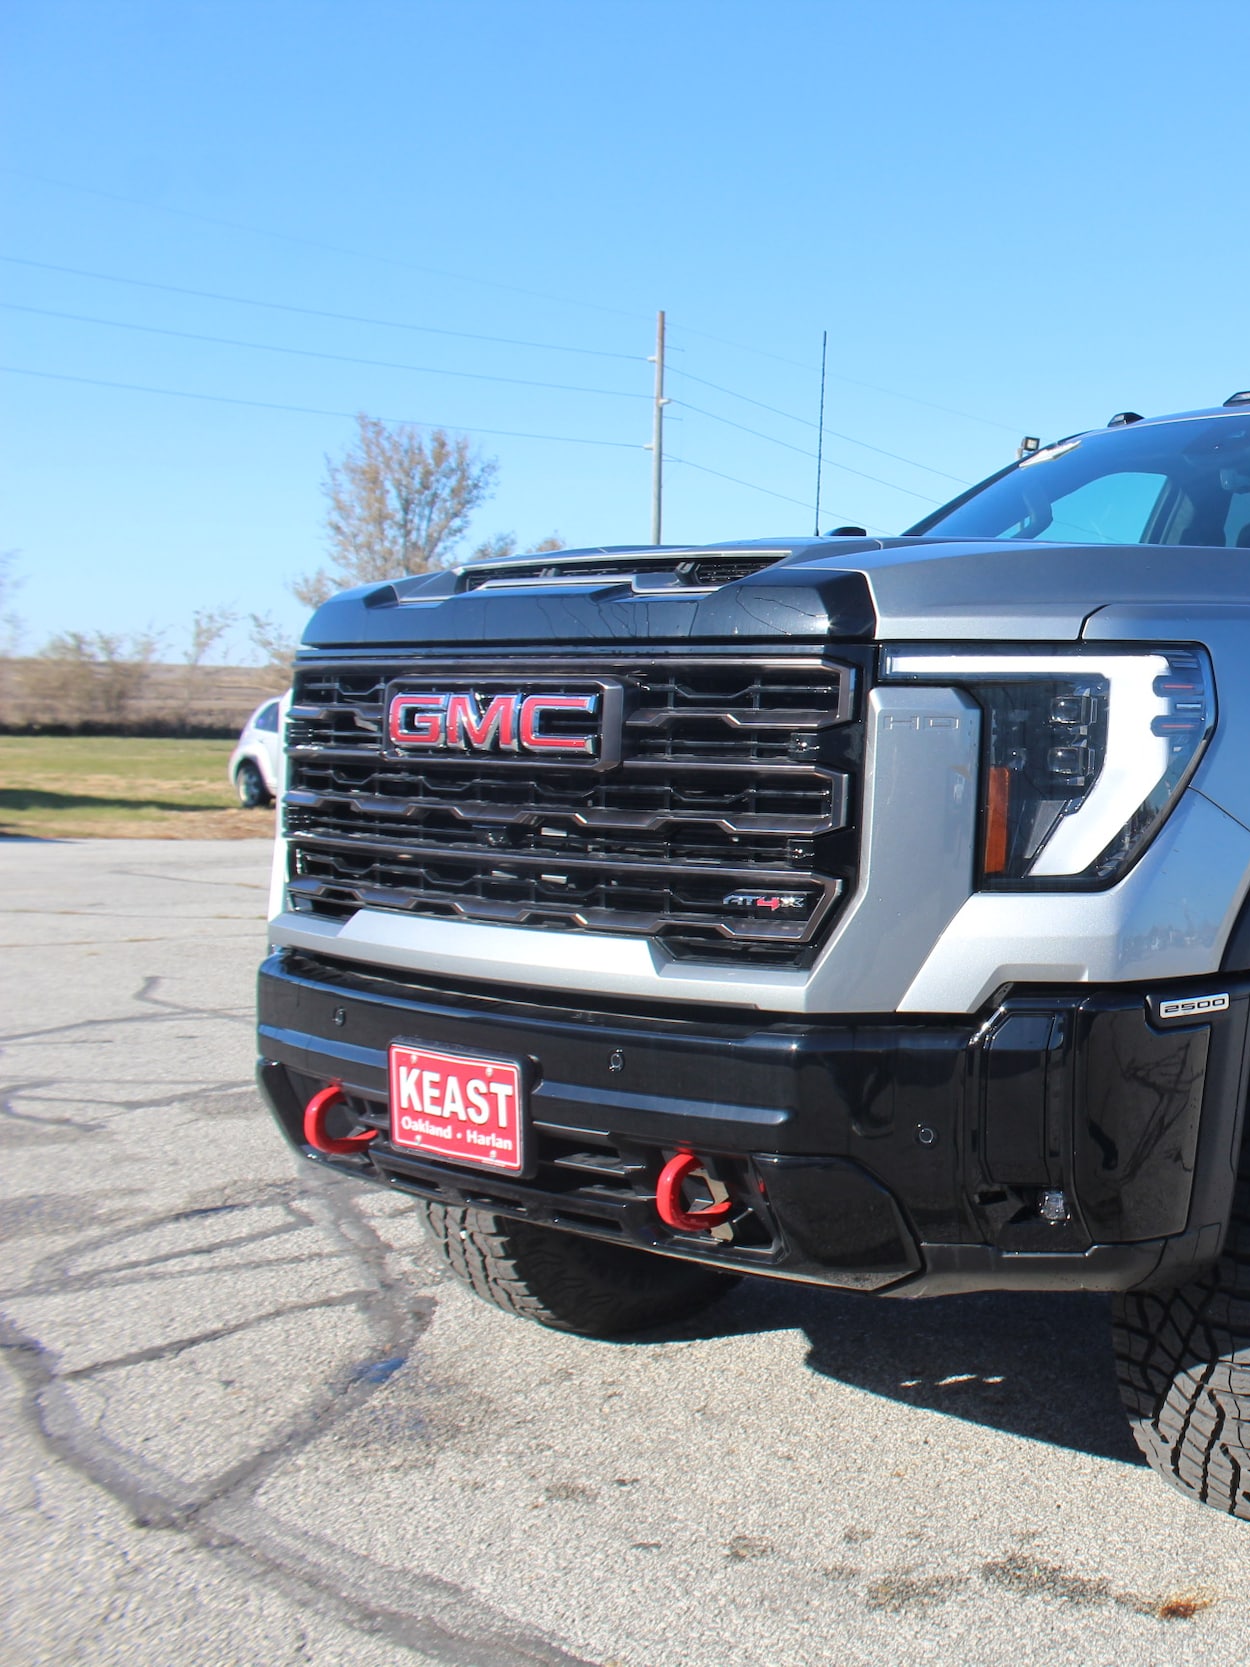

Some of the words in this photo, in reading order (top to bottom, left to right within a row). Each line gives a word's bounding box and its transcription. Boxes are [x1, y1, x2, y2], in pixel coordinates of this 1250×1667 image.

[389, 691, 597, 754] GMC
[883, 715, 960, 731] HD
[1165, 998, 1226, 1013] 2500
[399, 1066, 514, 1129] KEAST
[401, 1115, 452, 1140] Oakland
[466, 1128, 513, 1151] Harlan
